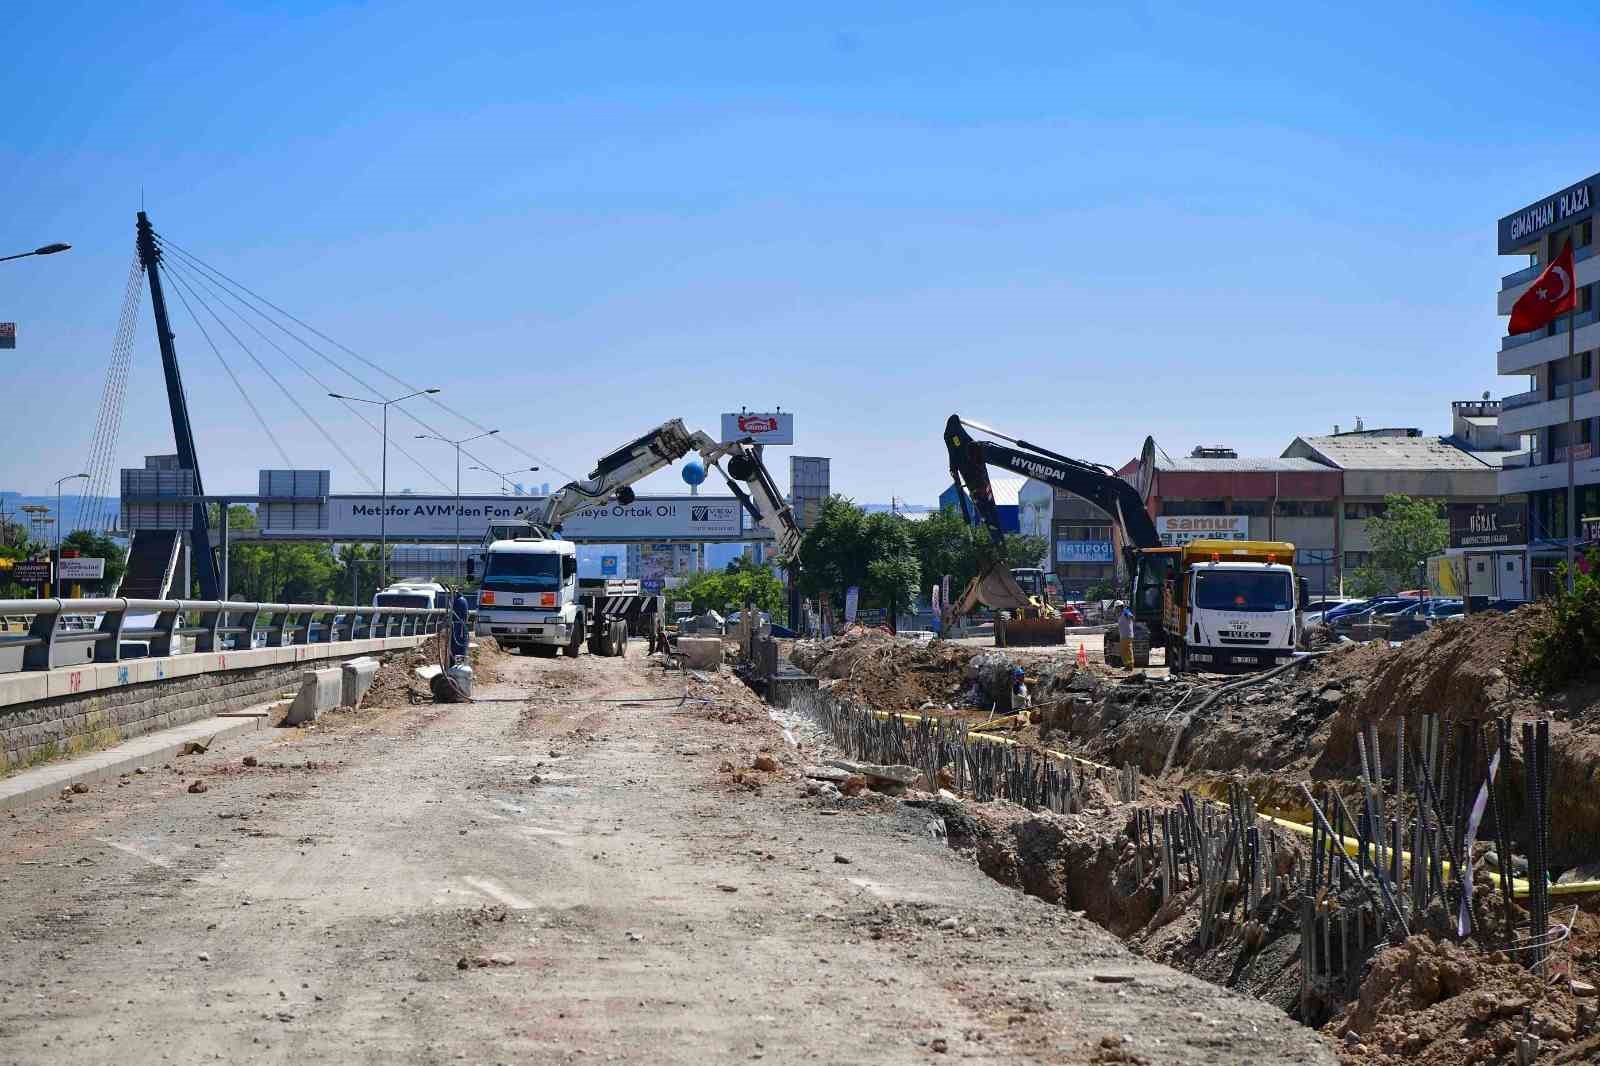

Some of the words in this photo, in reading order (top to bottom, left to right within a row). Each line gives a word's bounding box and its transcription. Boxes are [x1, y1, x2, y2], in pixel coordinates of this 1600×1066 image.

[1560, 185, 1590, 219] PLAZA
[1011, 456, 1066, 481] HYUNDAI
[413, 504, 481, 517] AVM'den
[484, 505, 510, 517] Fon
[612, 505, 653, 518] Ortak
[656, 505, 677, 518] Ol!
[1166, 517, 1239, 530] samur
[1228, 630, 1261, 638] IVECO
